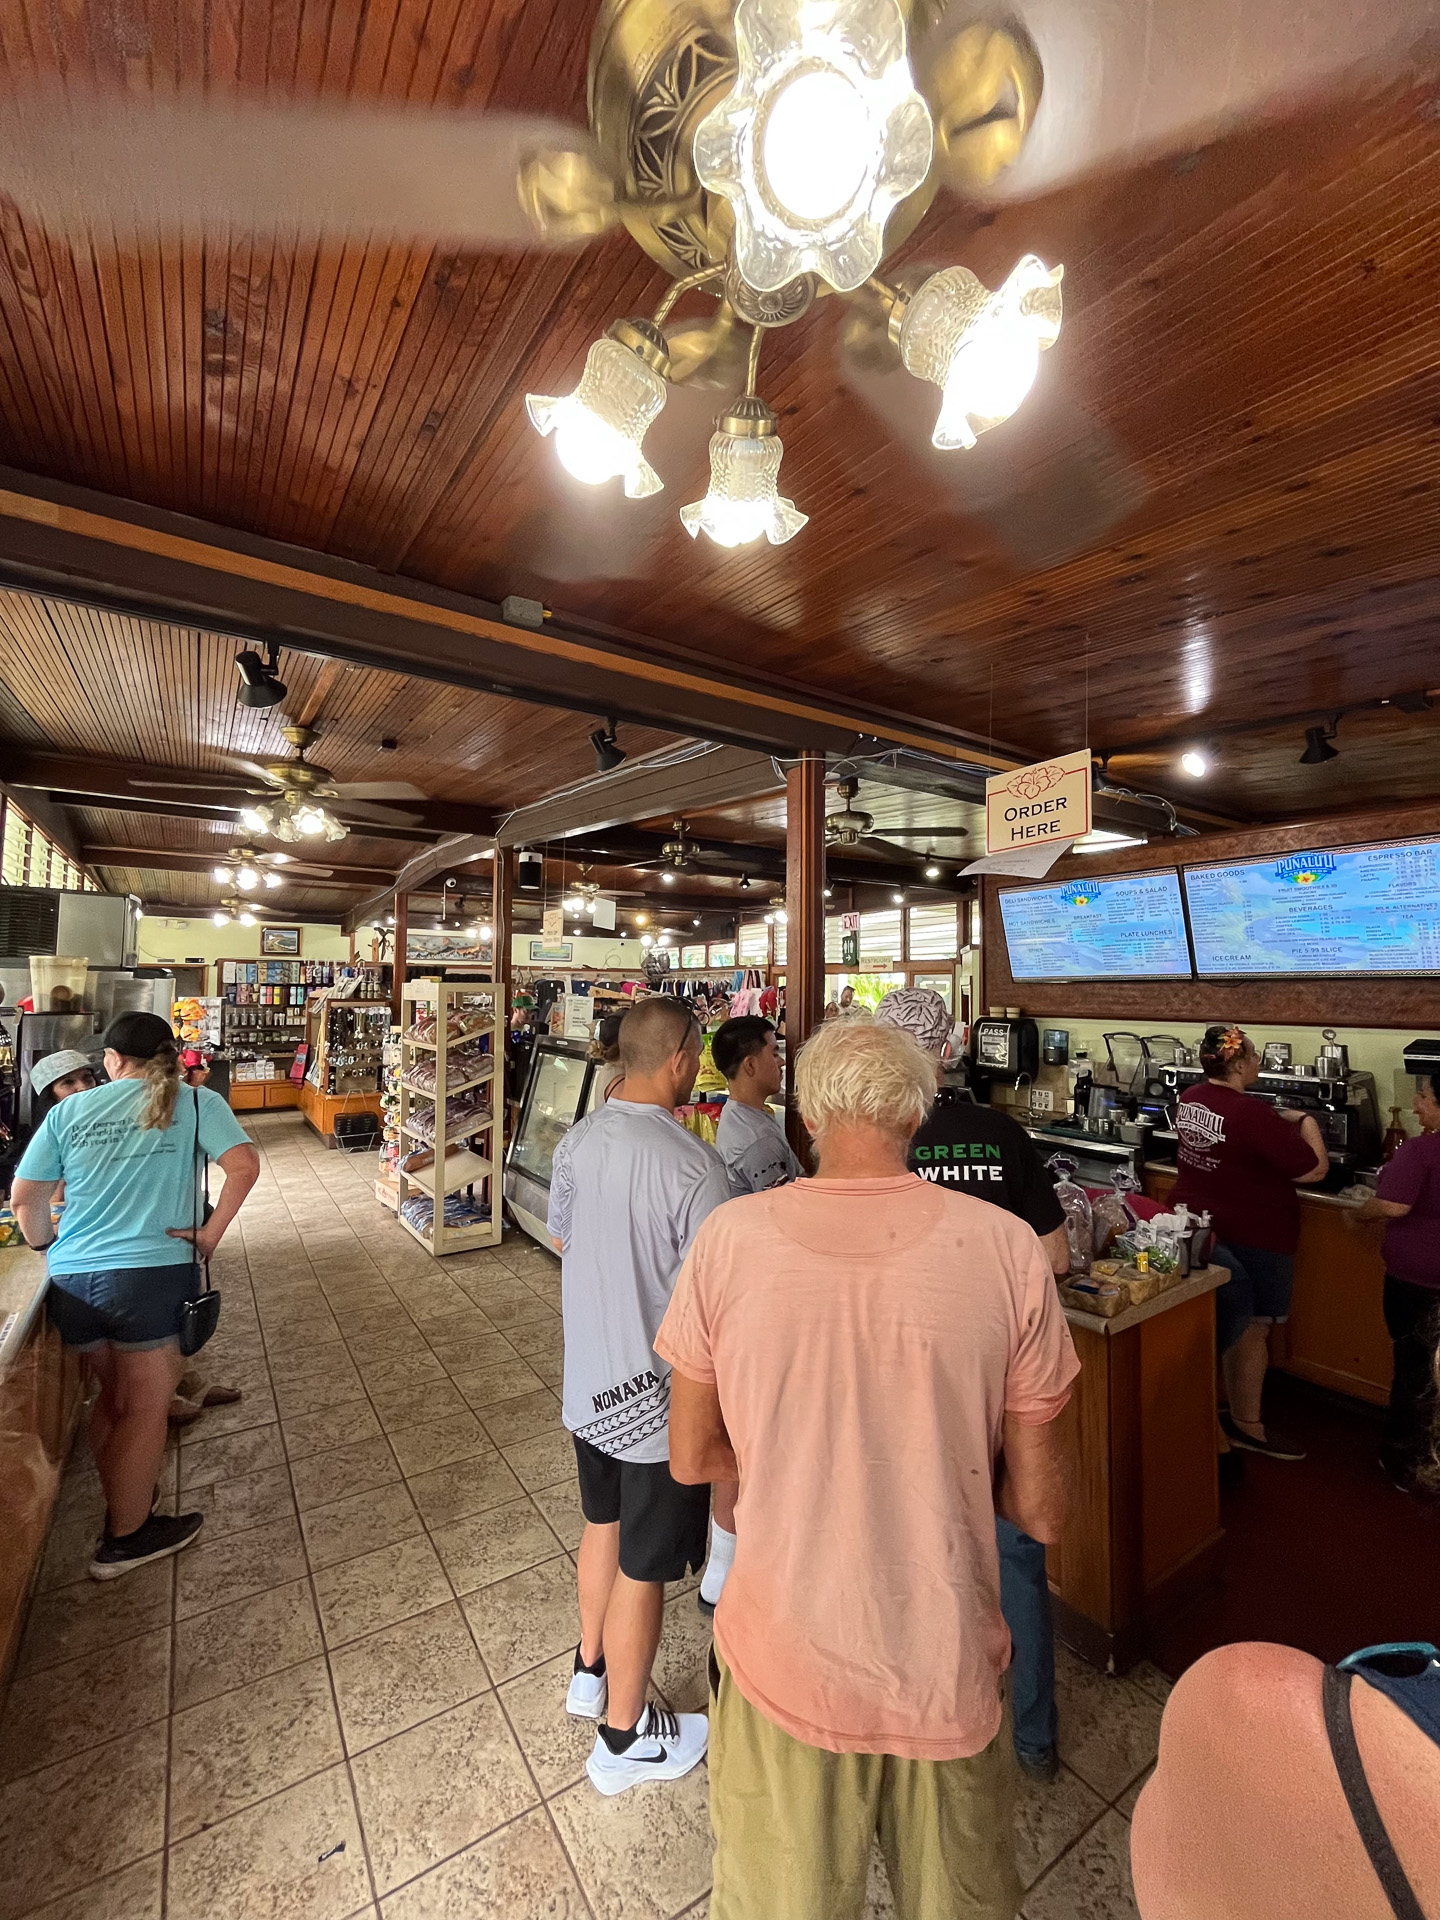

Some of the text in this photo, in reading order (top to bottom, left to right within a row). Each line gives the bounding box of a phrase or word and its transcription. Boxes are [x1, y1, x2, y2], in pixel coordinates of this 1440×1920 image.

[1004, 797, 1067, 821] ORDER
[1011, 820, 1060, 841] HERE
[1368, 849, 1433, 861] ESPRESSO BAR
[1190, 870, 1245, 881] BAKED GOODS
[1115, 889, 1138, 897] SOUPS
[1145, 886, 1168, 894] SALAD
[1288, 904, 1333, 913] BEVERAGES
[844, 914, 858, 929] EXIT
[1141, 929, 1173, 937] LUNCHES
[983, 1028, 1004, 1037] PASS
[915, 1143, 1001, 1160] GREEN
[917, 1165, 1003, 1181] WHITE
[591, 1370, 660, 1414] NONAKA
